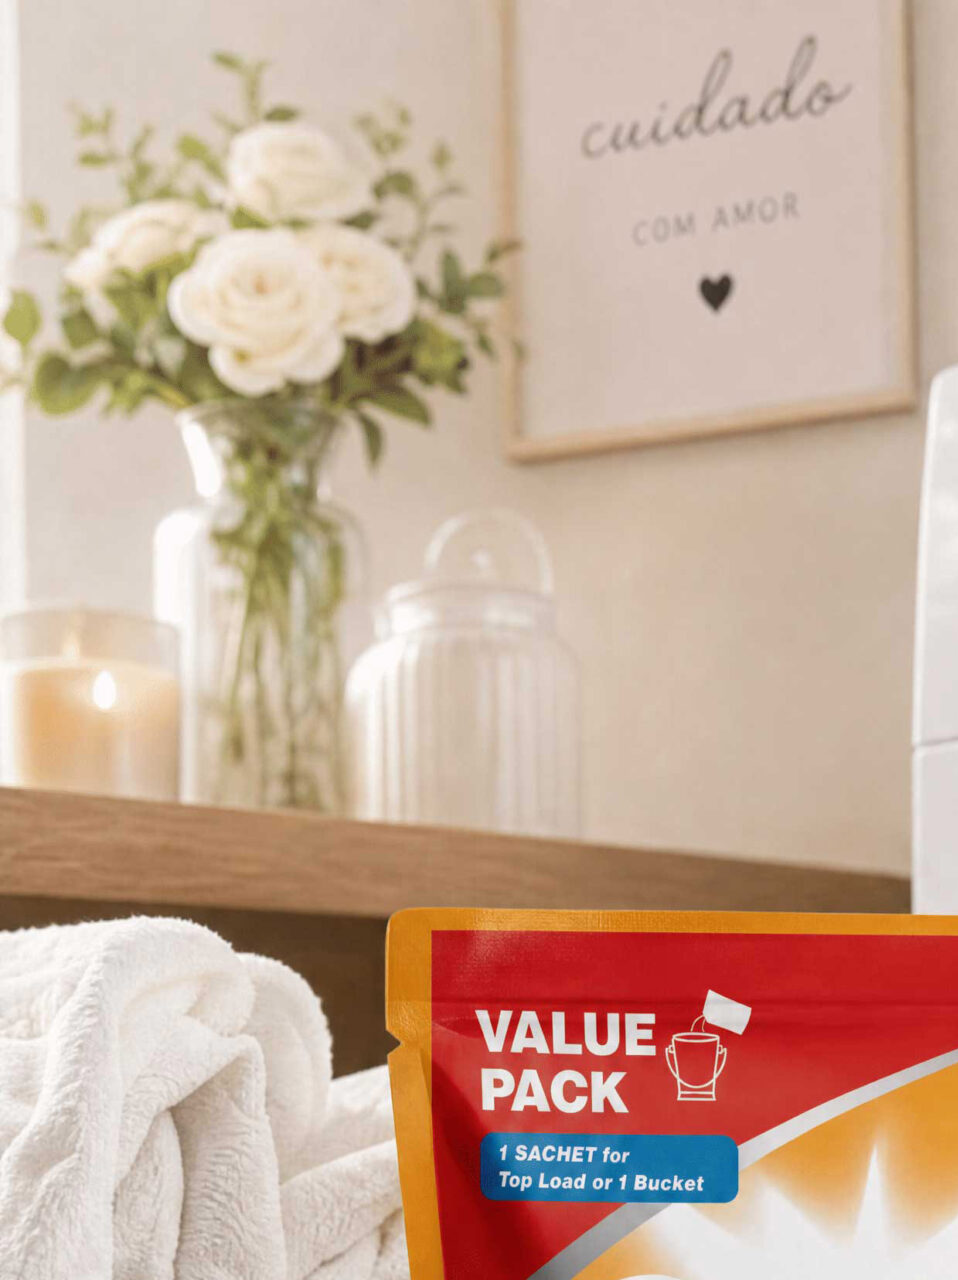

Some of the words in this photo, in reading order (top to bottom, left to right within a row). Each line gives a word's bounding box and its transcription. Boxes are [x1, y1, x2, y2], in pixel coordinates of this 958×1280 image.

[581, 34, 853, 159] cuidado
[632, 212, 696, 247] COM
[711, 191, 799, 233] AMOR
[475, 1009, 657, 1057] VALUE
[480, 1068, 629, 1114] PACK
[499, 1144, 508, 1161] 1
[514, 1145, 598, 1163] SACHET
[602, 1147, 630, 1163] for
[499, 1171, 533, 1191] Top
[538, 1172, 587, 1190] Load
[592, 1178, 612, 1190] or
[618, 1174, 627, 1190] 1
[633, 1175, 705, 1191] Bucket
